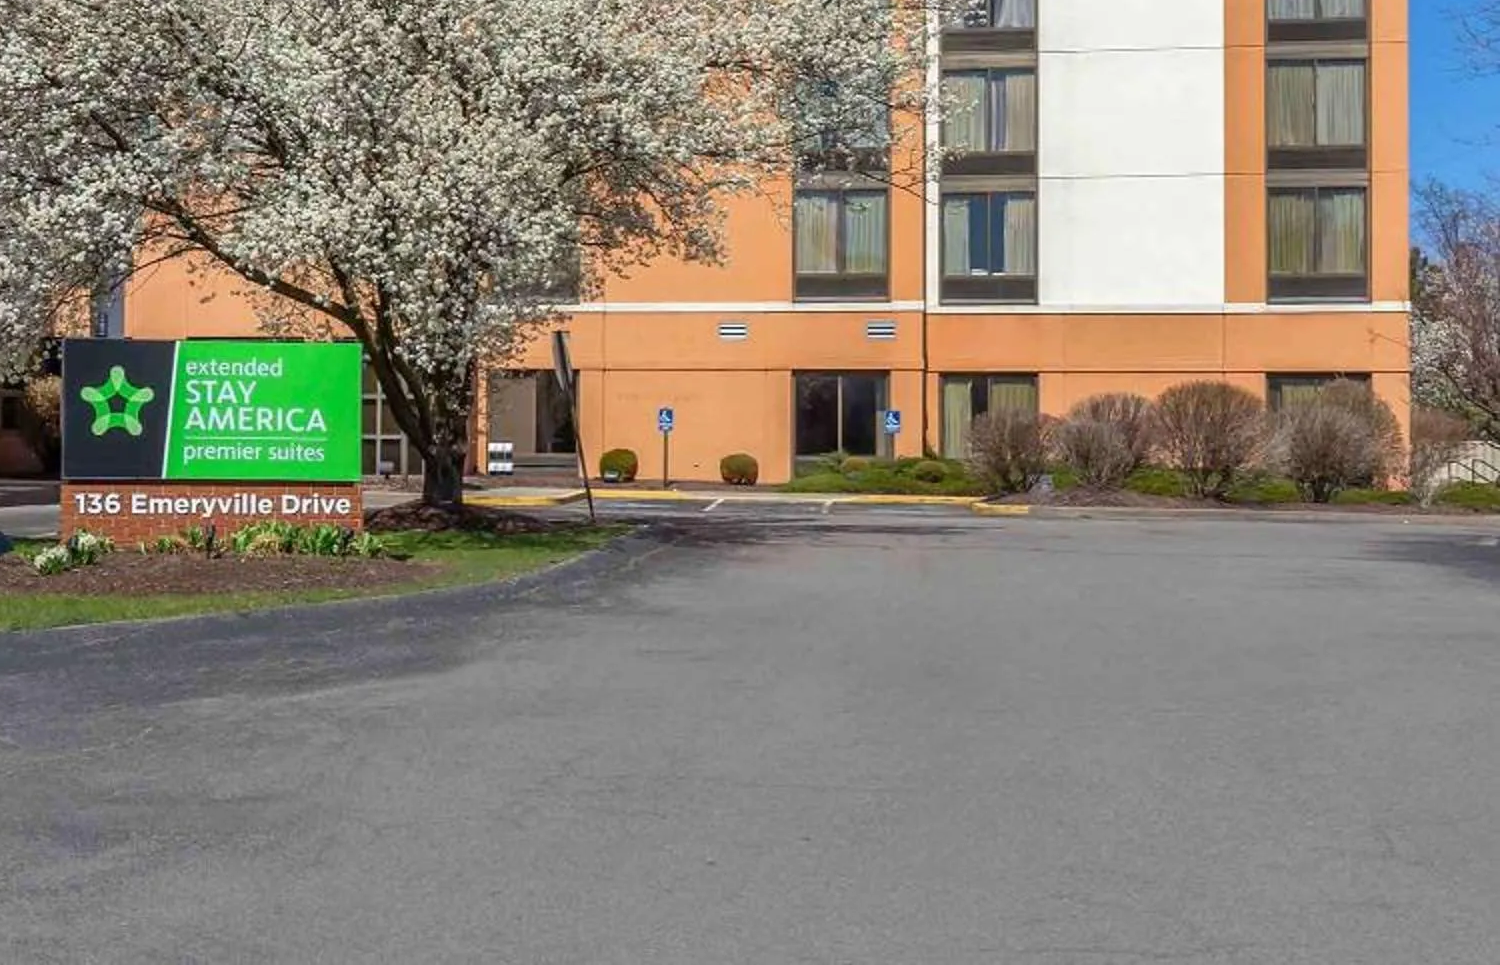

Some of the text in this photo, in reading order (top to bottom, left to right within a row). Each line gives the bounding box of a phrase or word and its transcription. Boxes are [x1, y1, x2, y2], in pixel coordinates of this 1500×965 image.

[185, 357, 283, 377] extended
[185, 380, 257, 405] STAY
[184, 408, 327, 432] AMERICA
[184, 442, 325, 464] premier suites
[76, 493, 351, 517] 136 Emeryville Drive
